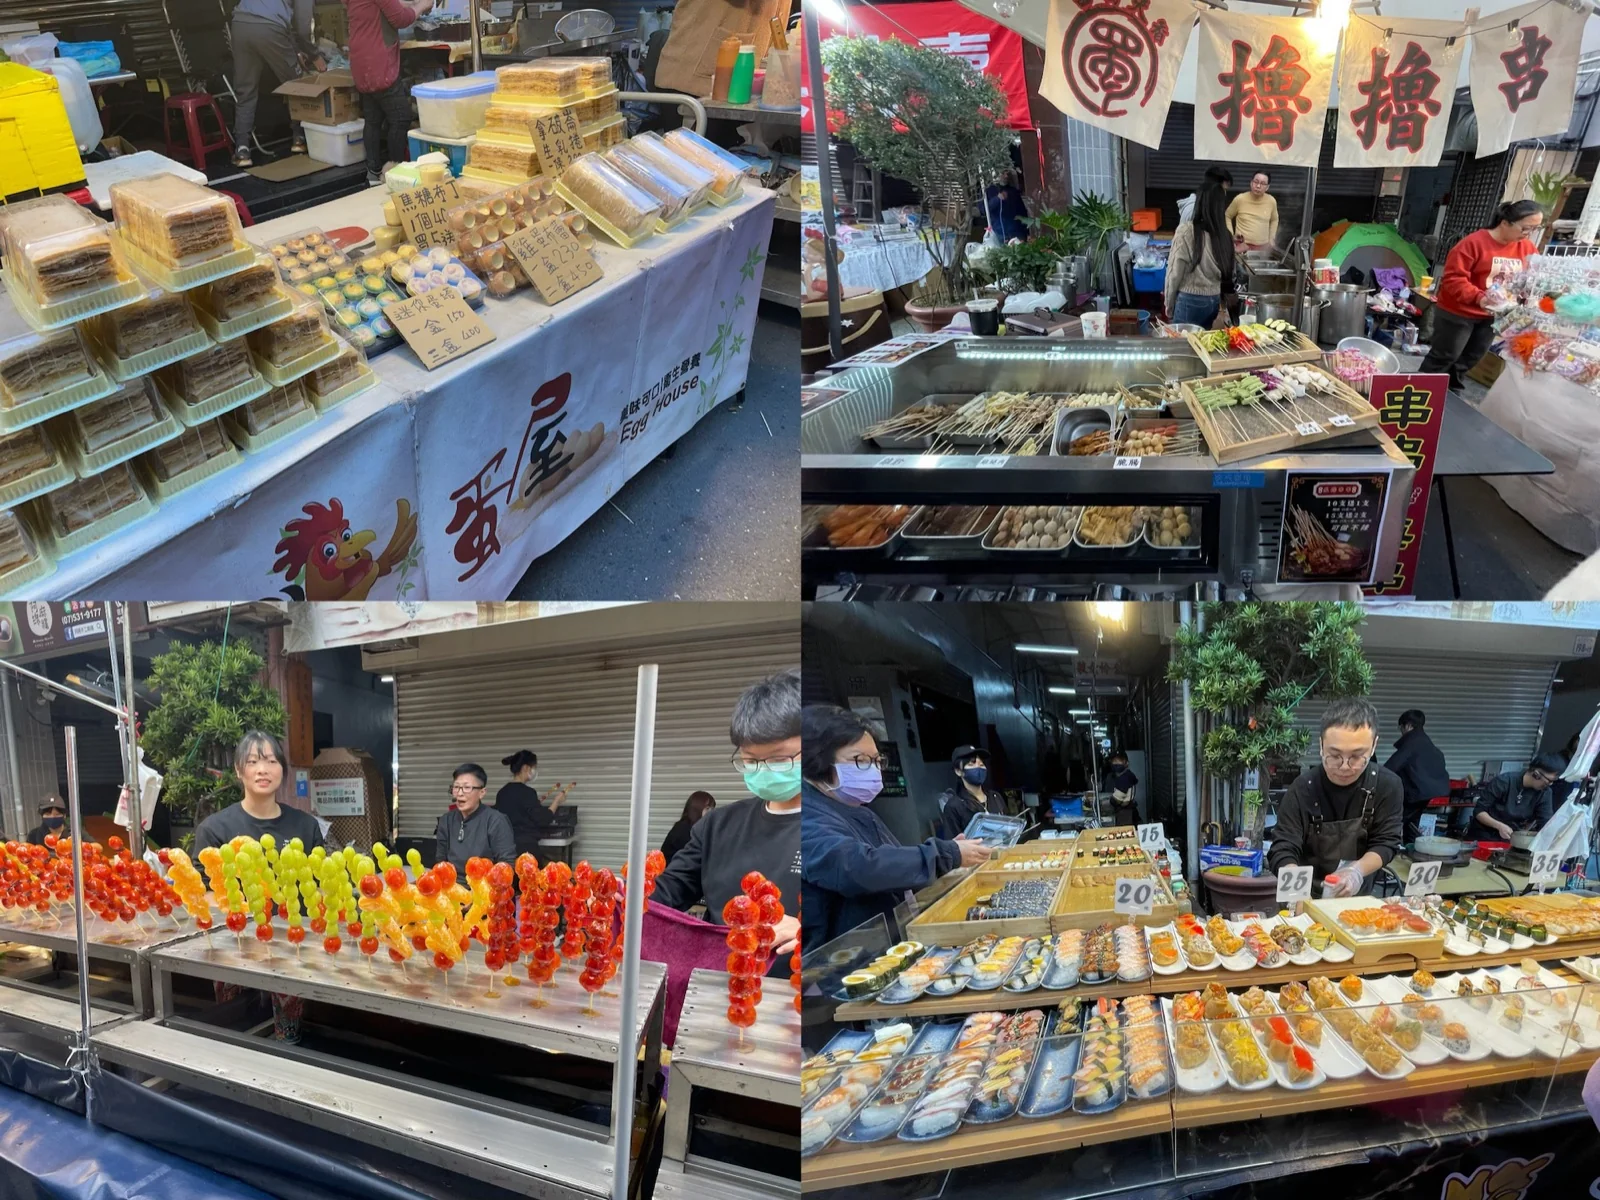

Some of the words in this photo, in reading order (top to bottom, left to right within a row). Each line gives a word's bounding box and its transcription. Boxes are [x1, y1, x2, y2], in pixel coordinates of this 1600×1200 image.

[1210, 34, 1312, 151] 擼
[1350, 41, 1442, 153] 擼
[535, 109, 577, 141] 拿破崙
[399, 180, 460, 213] 焦糖布丁
[552, 241, 580, 264] 230
[569, 261, 593, 282] 450
[447, 311, 465, 323] 150
[461, 326, 481, 340] 400
[620, 410, 650, 444] Egg
[652, 375, 699, 417] House
[61, 608, 101, 625] (07)531-9177
[1141, 826, 1159, 842] 15
[1532, 853, 1559, 874] 35
[1279, 871, 1308, 892] 25
[1408, 865, 1439, 886] 30
[1117, 883, 1151, 905] 20
